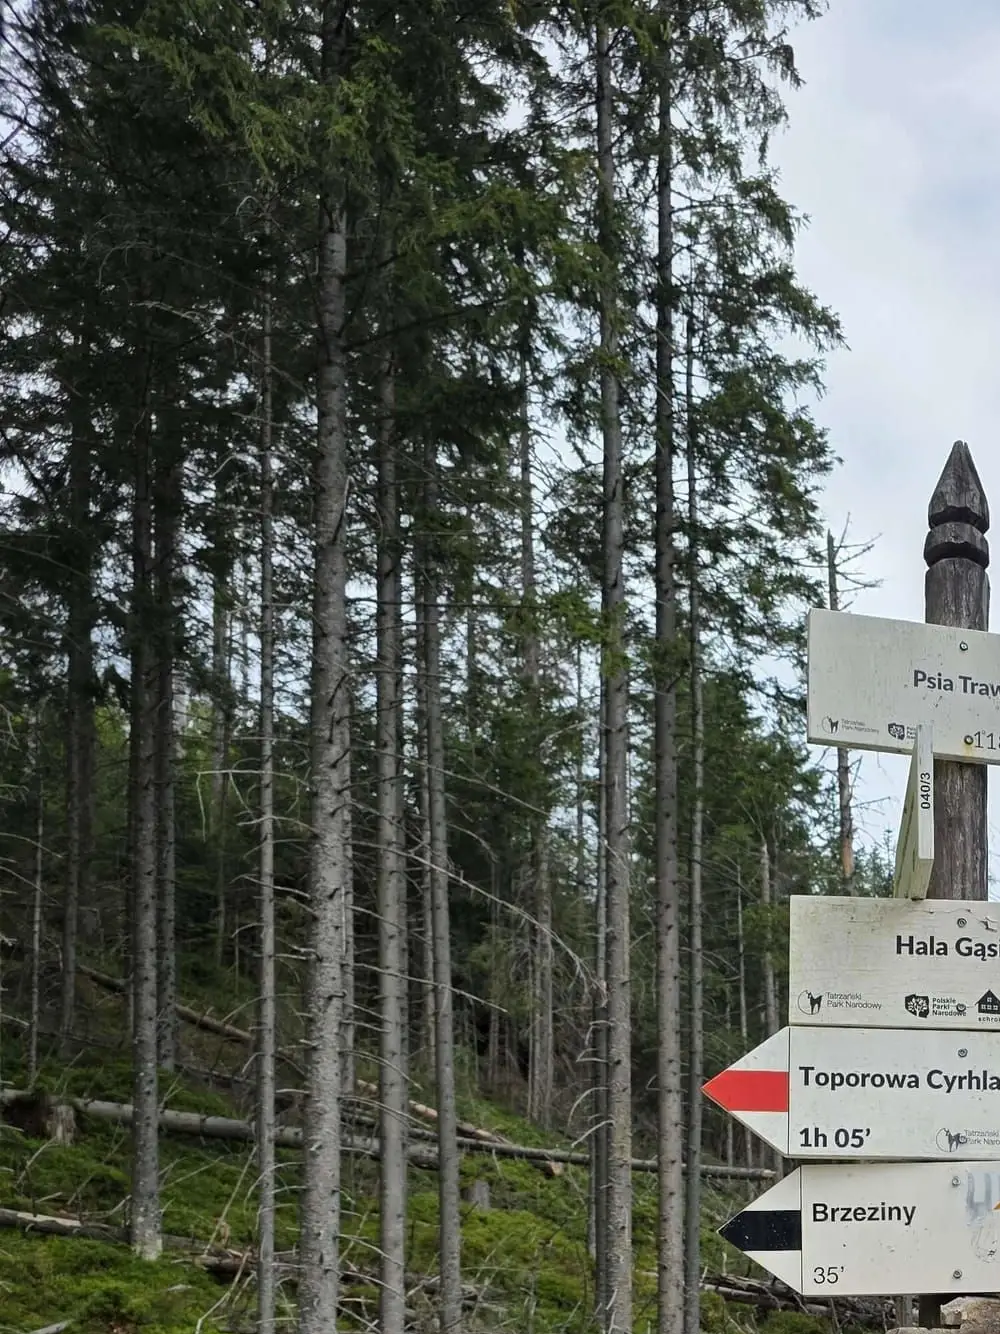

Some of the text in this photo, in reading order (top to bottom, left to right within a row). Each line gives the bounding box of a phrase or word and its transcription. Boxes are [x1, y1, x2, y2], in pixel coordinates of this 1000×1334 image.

[913, 669, 954, 692] Psia
[920, 772, 931, 809] 040/3
[896, 935, 948, 956] Hala
[826, 1000, 882, 1010] Park Narodowy
[798, 1066, 1000, 1093] Toporowa Cyrhla
[799, 1127, 871, 1149] 1h 05'
[812, 1201, 917, 1226] Brzeziny
[813, 1266, 845, 1285] 35'
